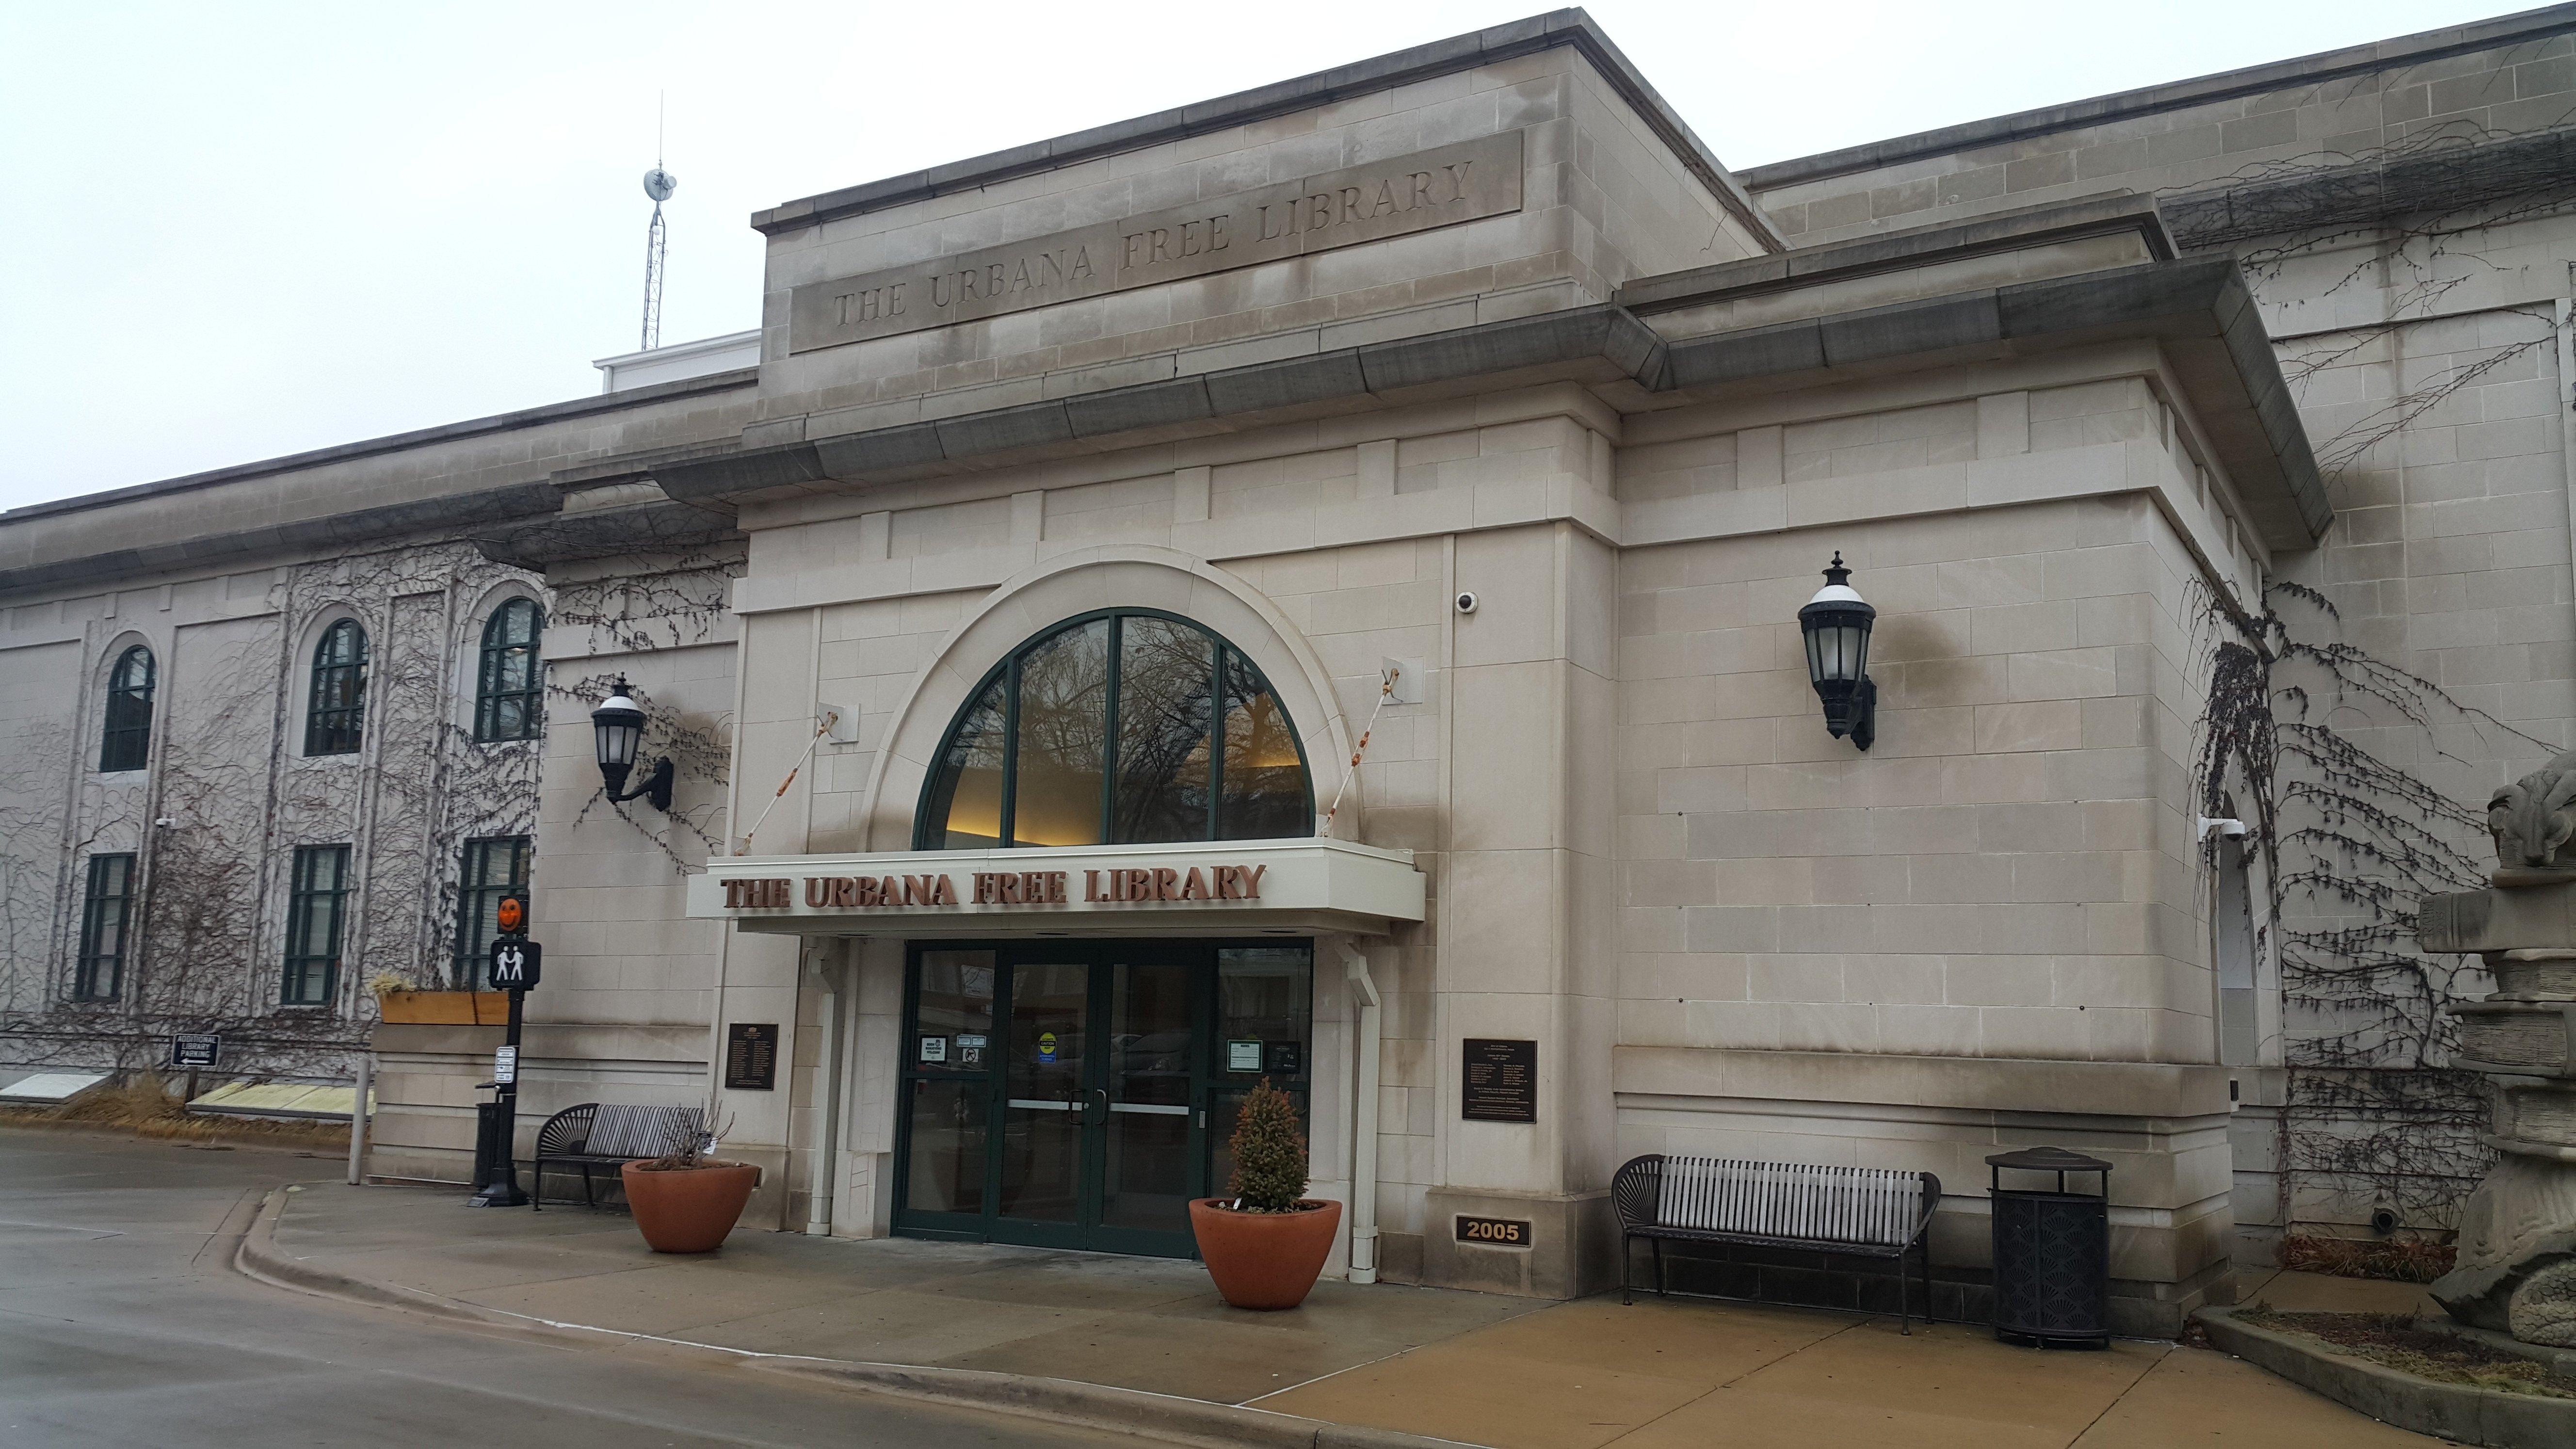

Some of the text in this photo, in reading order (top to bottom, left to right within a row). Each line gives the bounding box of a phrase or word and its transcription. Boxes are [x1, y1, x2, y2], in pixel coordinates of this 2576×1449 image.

[835, 161, 1474, 326] THE URBANA FREE LIBRARY
[720, 864, 1267, 908] THE URBANA FREE LIBRARY
[177, 1035, 217, 1044] ADDITIONAL
[1467, 1221, 1519, 1240] 2005
